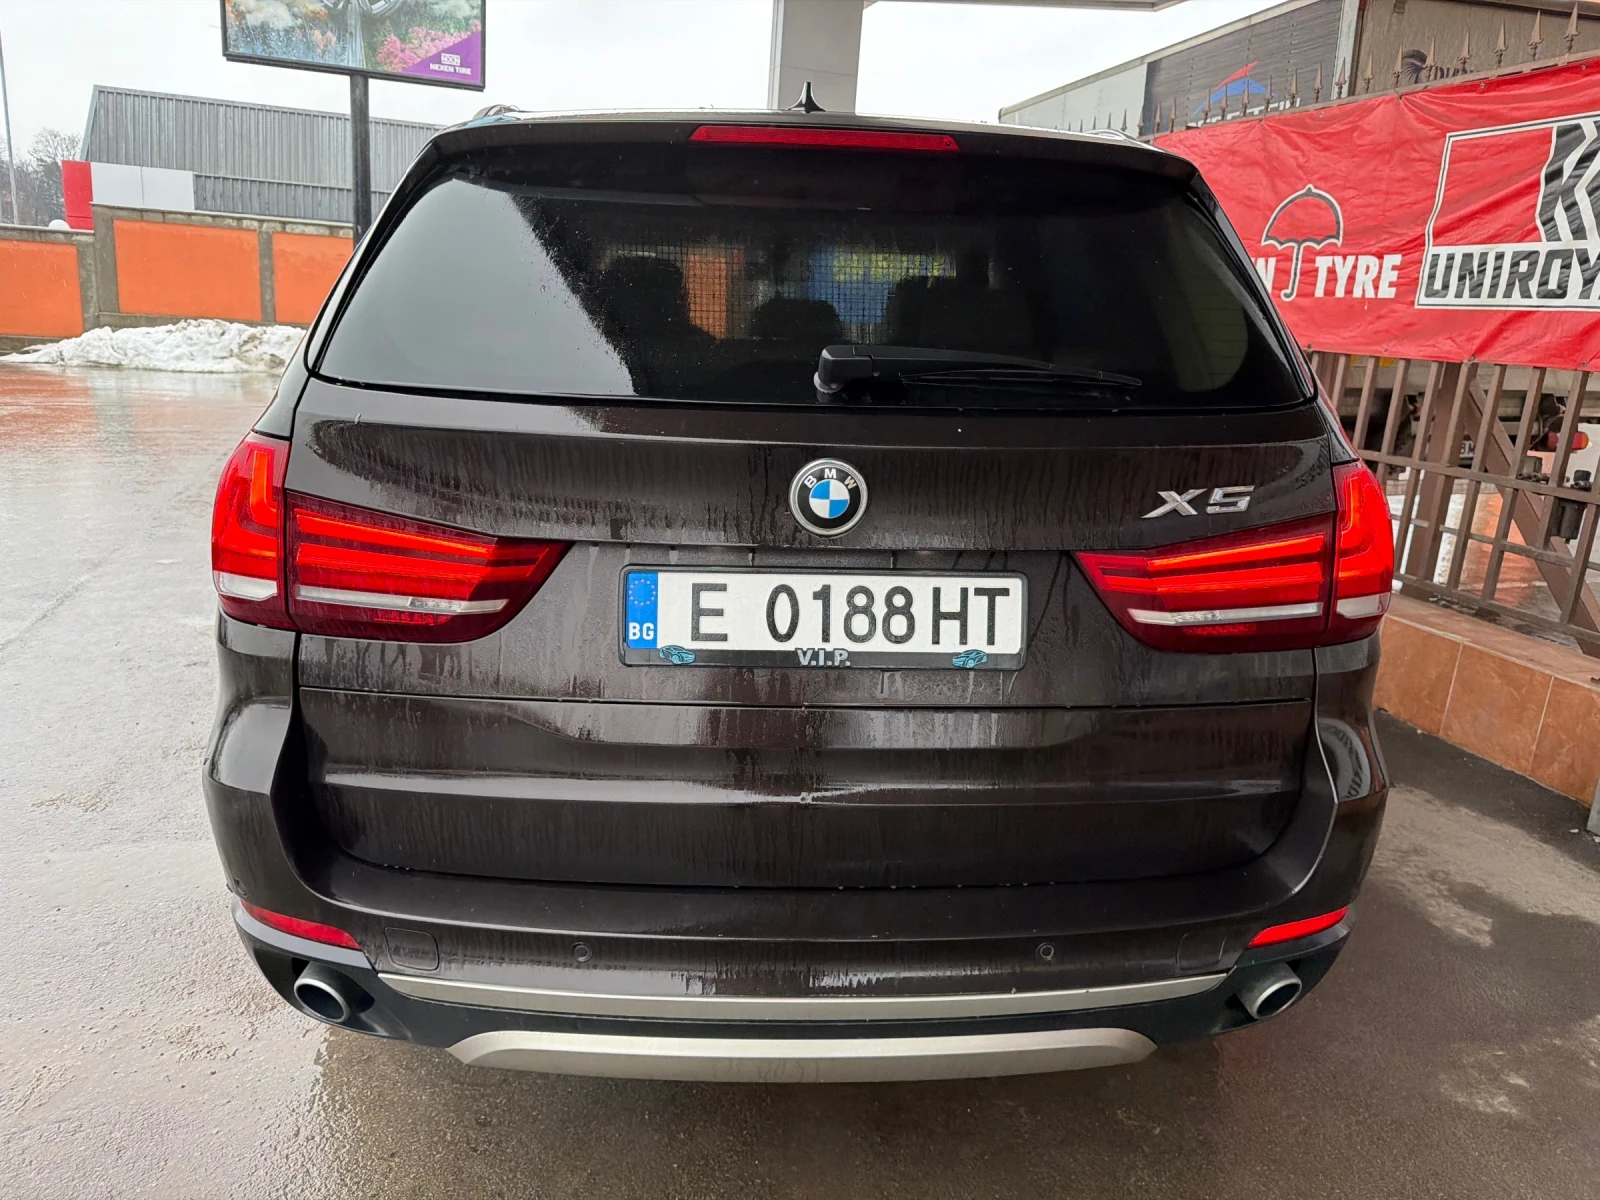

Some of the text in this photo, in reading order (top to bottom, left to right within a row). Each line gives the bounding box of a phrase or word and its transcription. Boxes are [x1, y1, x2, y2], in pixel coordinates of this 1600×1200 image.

[429, 63, 472, 75] NEXEN TIRE
[1314, 254, 1402, 299] TYRE
[1423, 247, 1600, 300] UNIROY
[803, 468, 857, 489] BMW
[1140, 485, 1255, 518] X5
[691, 583, 728, 642] E
[628, 622, 655, 640] BG
[795, 647, 851, 667] V.I.P.
